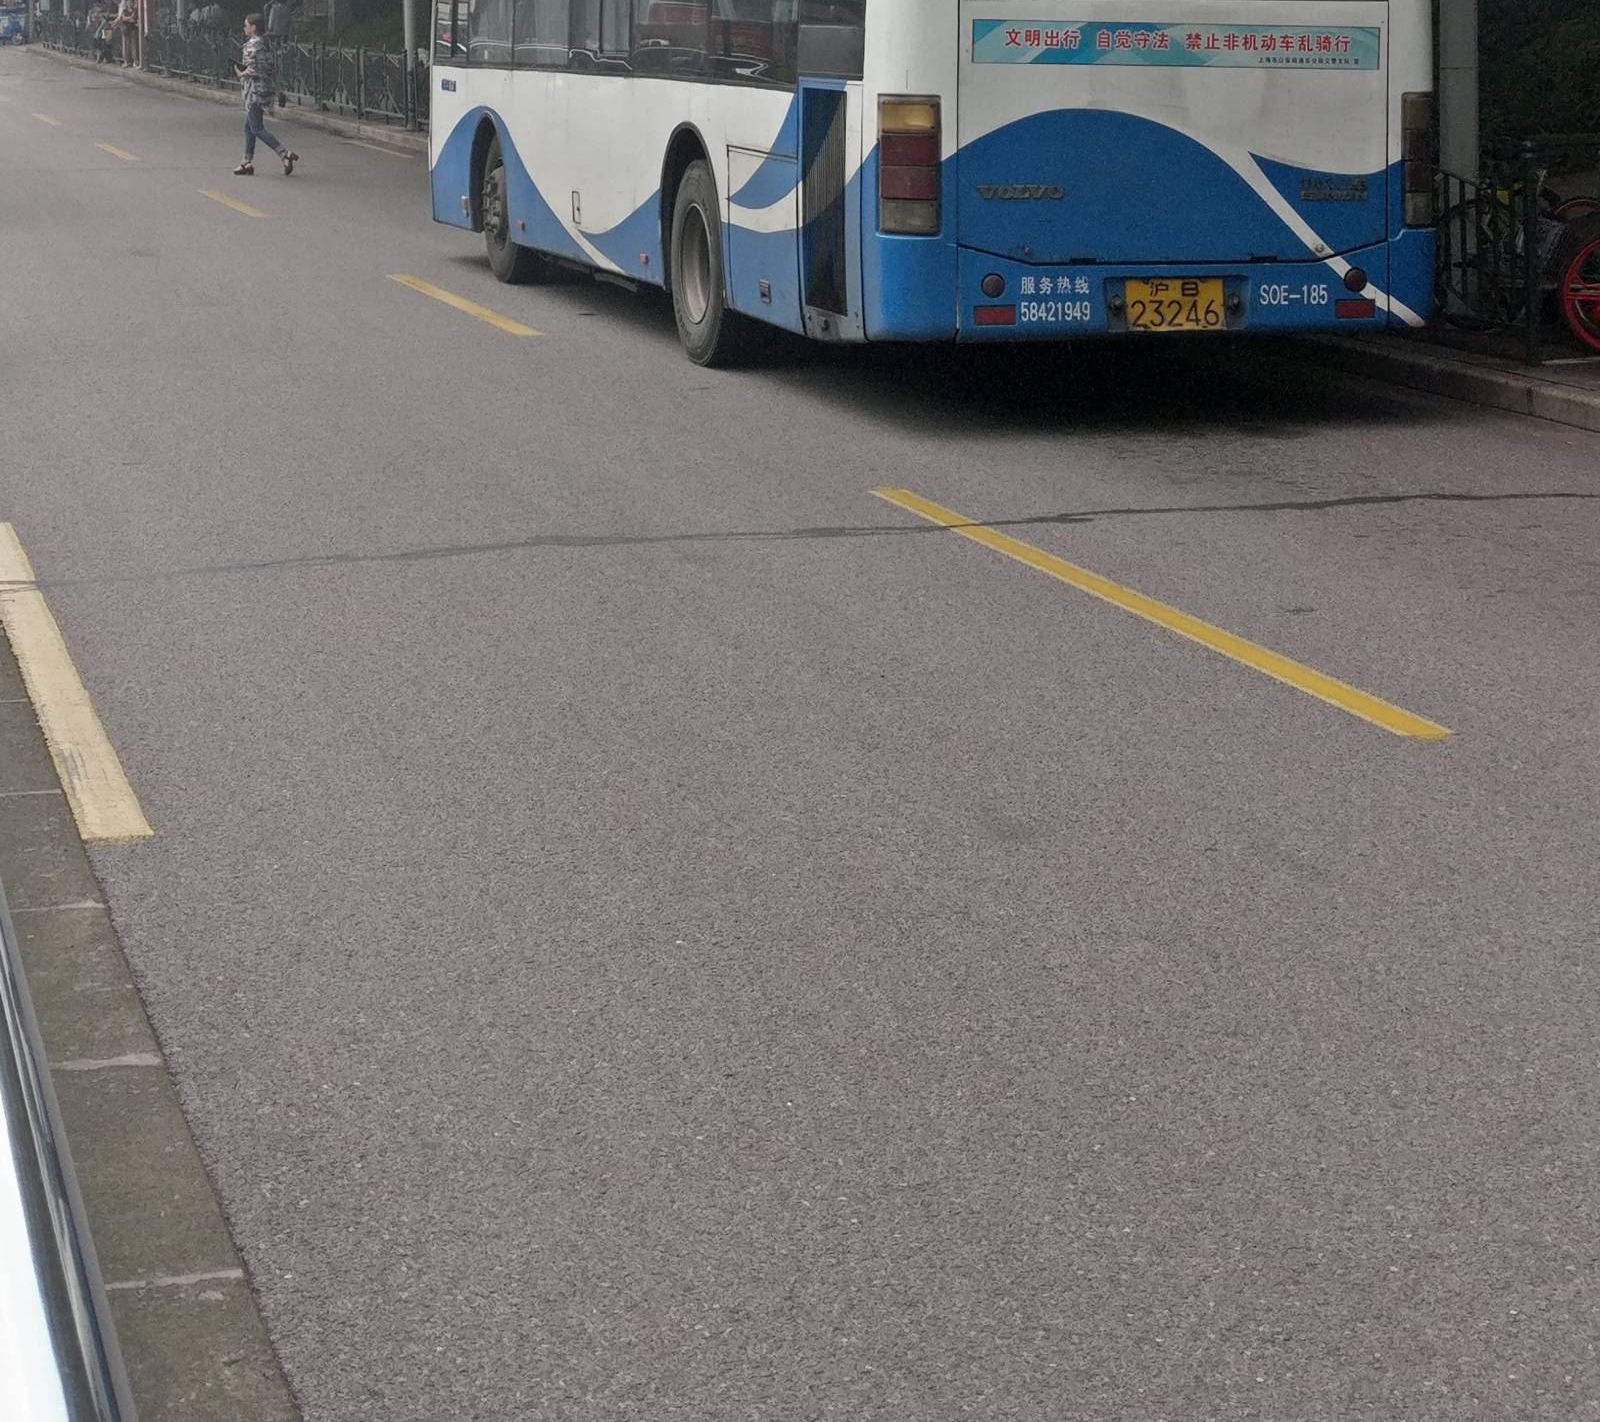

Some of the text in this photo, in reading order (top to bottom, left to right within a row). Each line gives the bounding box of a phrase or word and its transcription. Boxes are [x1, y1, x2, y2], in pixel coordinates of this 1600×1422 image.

[1005, 28, 1350, 52] 文明出行 自觉守法 禁止非机动车乱骑行
[1022, 276, 1090, 295] 服务热线
[1259, 284, 1329, 306] SOE-185
[1022, 300, 1091, 322] 58421949
[1130, 299, 1220, 328] 23246
